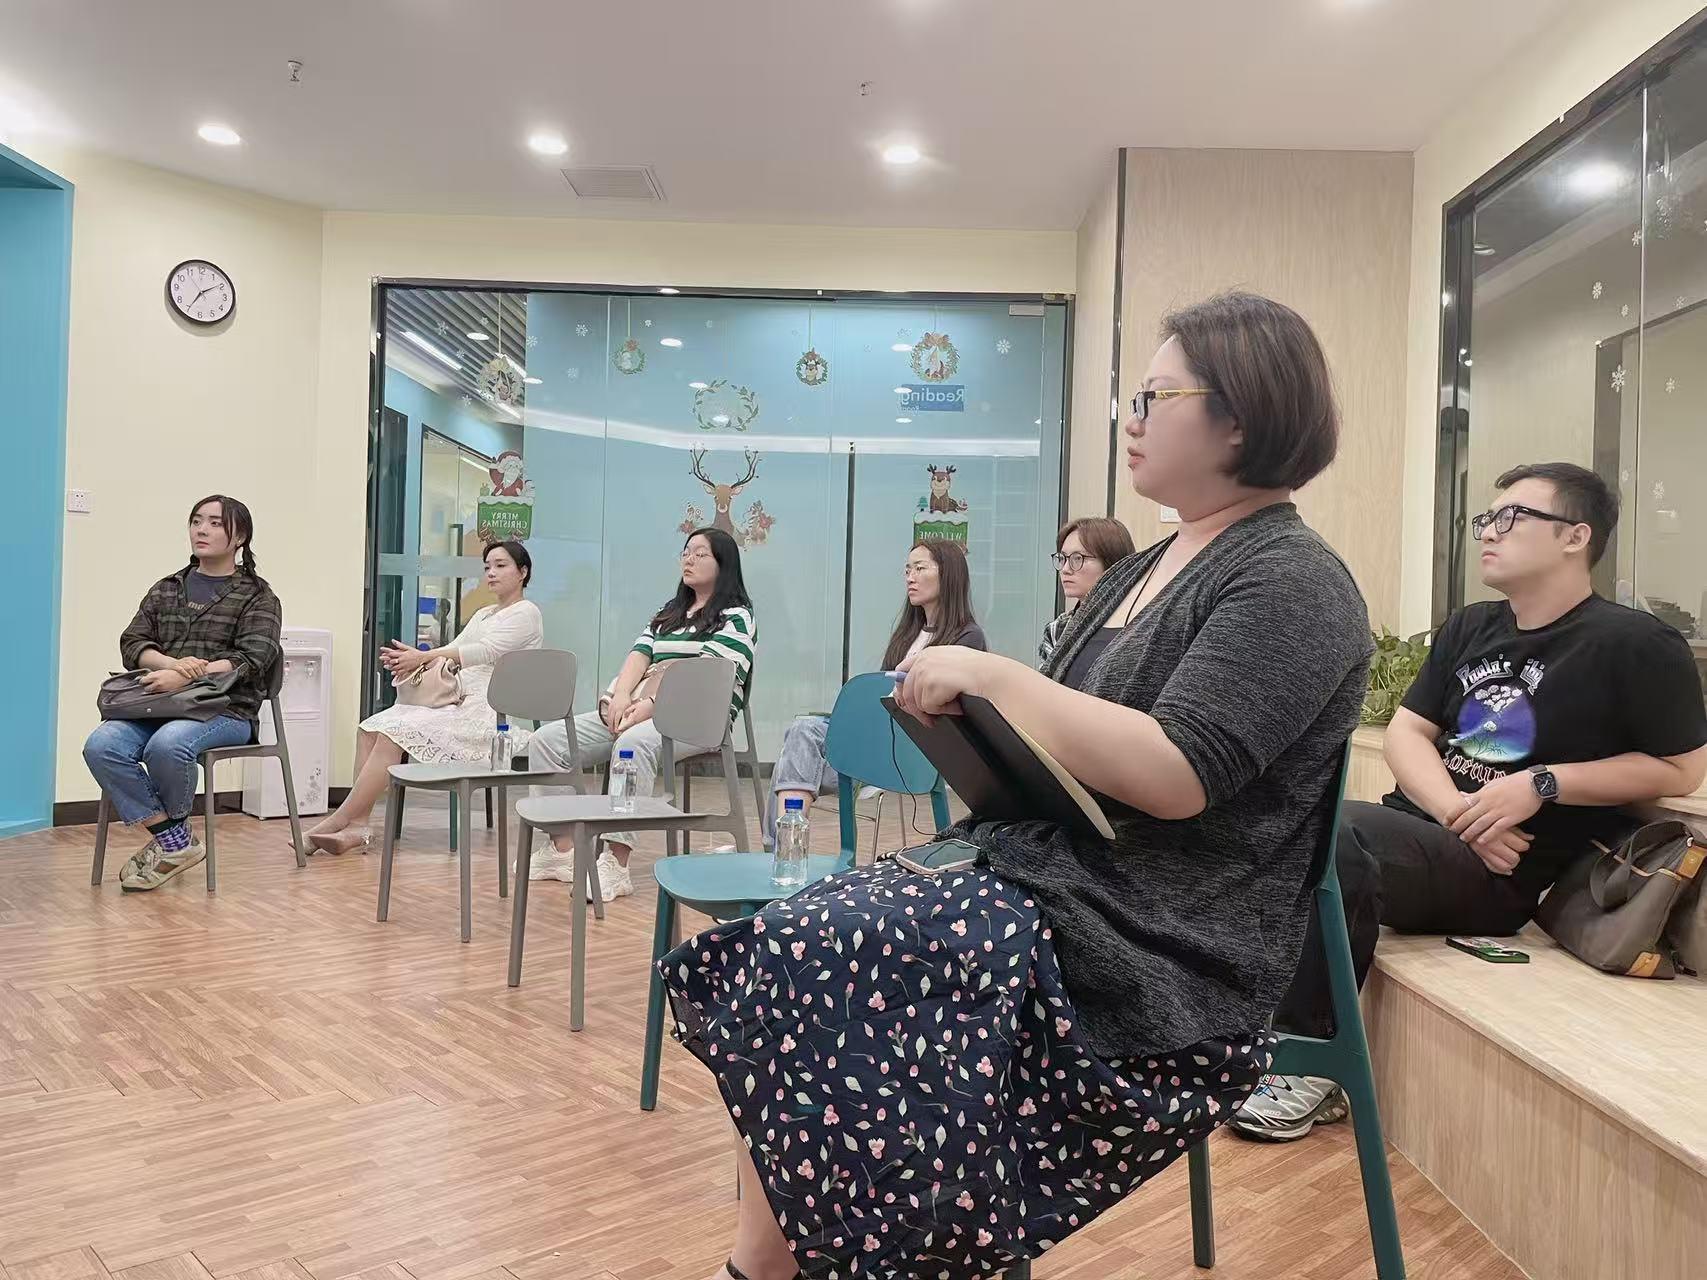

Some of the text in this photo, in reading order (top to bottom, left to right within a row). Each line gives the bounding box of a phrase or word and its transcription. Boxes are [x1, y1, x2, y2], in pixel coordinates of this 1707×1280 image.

[186, 268, 194, 276] 11
[199, 267, 206, 275] 12
[177, 274, 185, 282] 10
[174, 283, 180, 291] 9
[177, 295, 183, 303] 8
[222, 294, 228, 302] 3
[218, 304, 224, 312] 4
[197, 311, 203, 319] 6
[209, 310, 215, 318] 5
